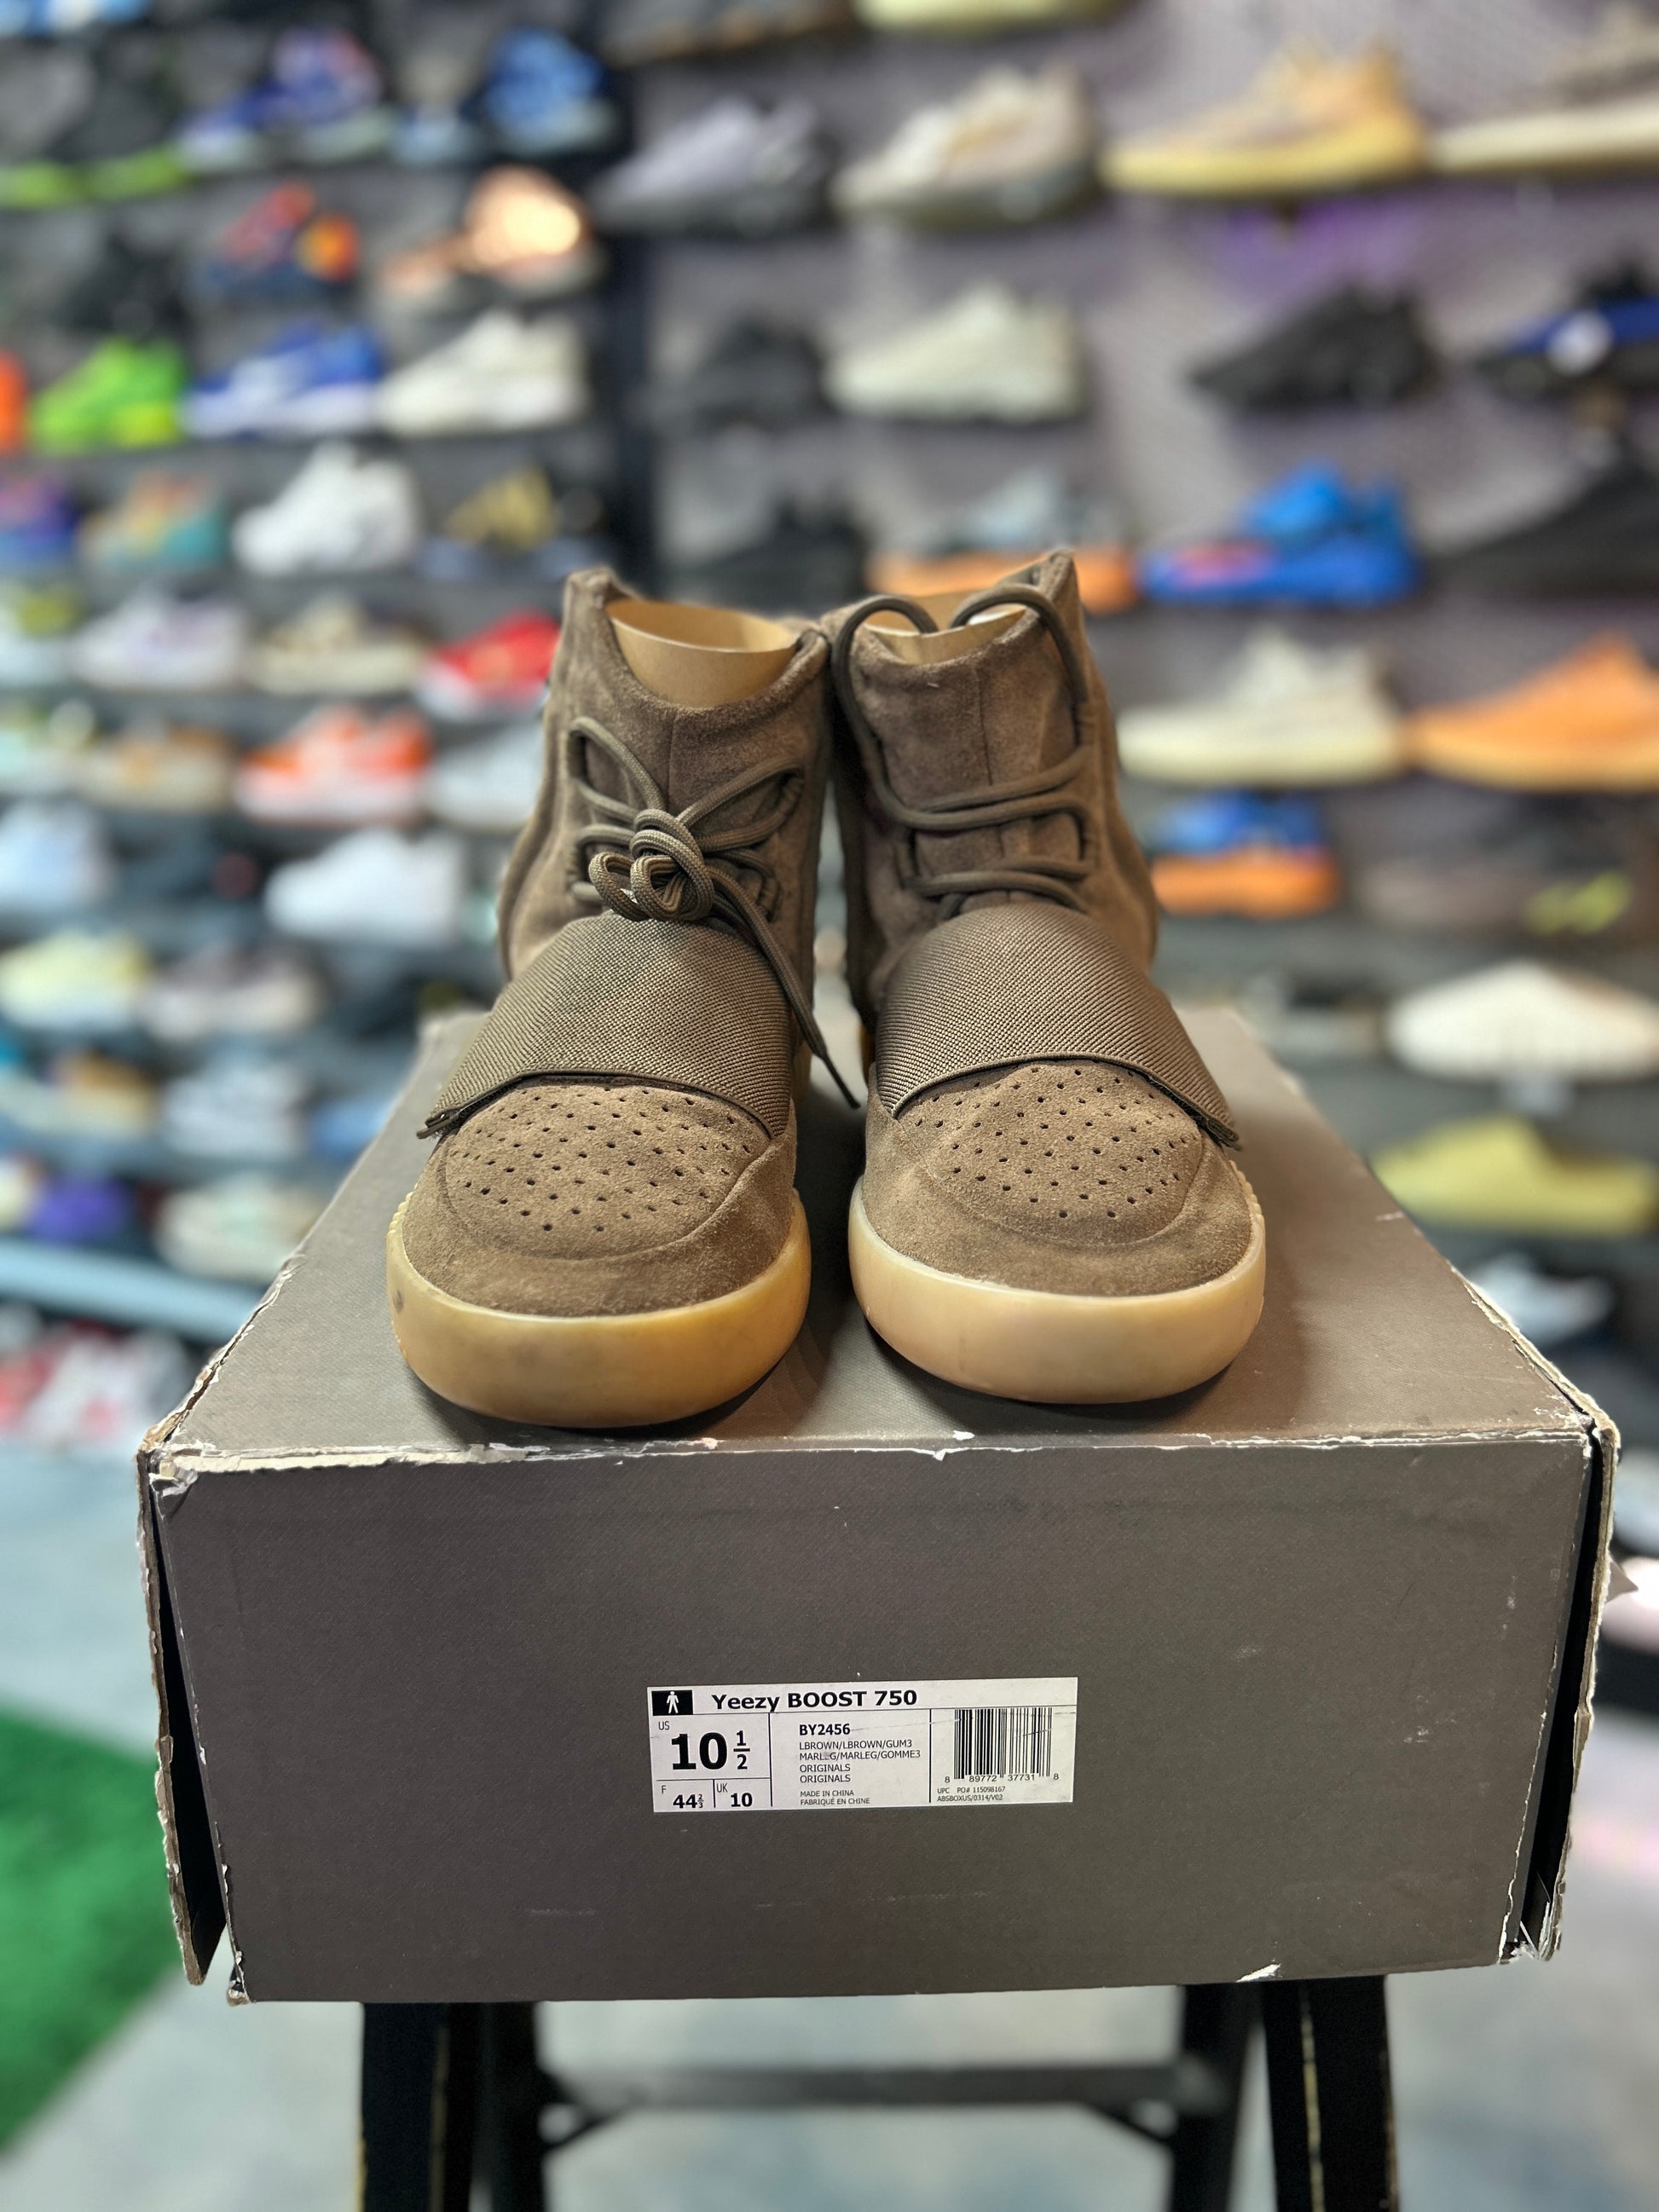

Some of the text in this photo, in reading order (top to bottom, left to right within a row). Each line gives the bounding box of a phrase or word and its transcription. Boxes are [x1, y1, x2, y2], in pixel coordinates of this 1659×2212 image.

[712, 1689, 917, 1712] Yeezy BOOST 750
[658, 1721, 669, 1730] US
[799, 1724, 851, 1736] BY2456
[799, 1739, 912, 1750] LBROWN/LBROWN/GUM3
[671, 1732, 727, 1770] 10
[800, 1764, 851, 1772] ORIGINALS
[800, 1775, 851, 1783] ORIGINALS
[969, 1774, 997, 1782] 89772
[1008, 1772, 1035, 1781] 37731
[661, 1785, 667, 1794] F
[716, 1783, 728, 1793] UK
[673, 1794, 697, 1808] 44
[731, 1793, 753, 1807] 10
